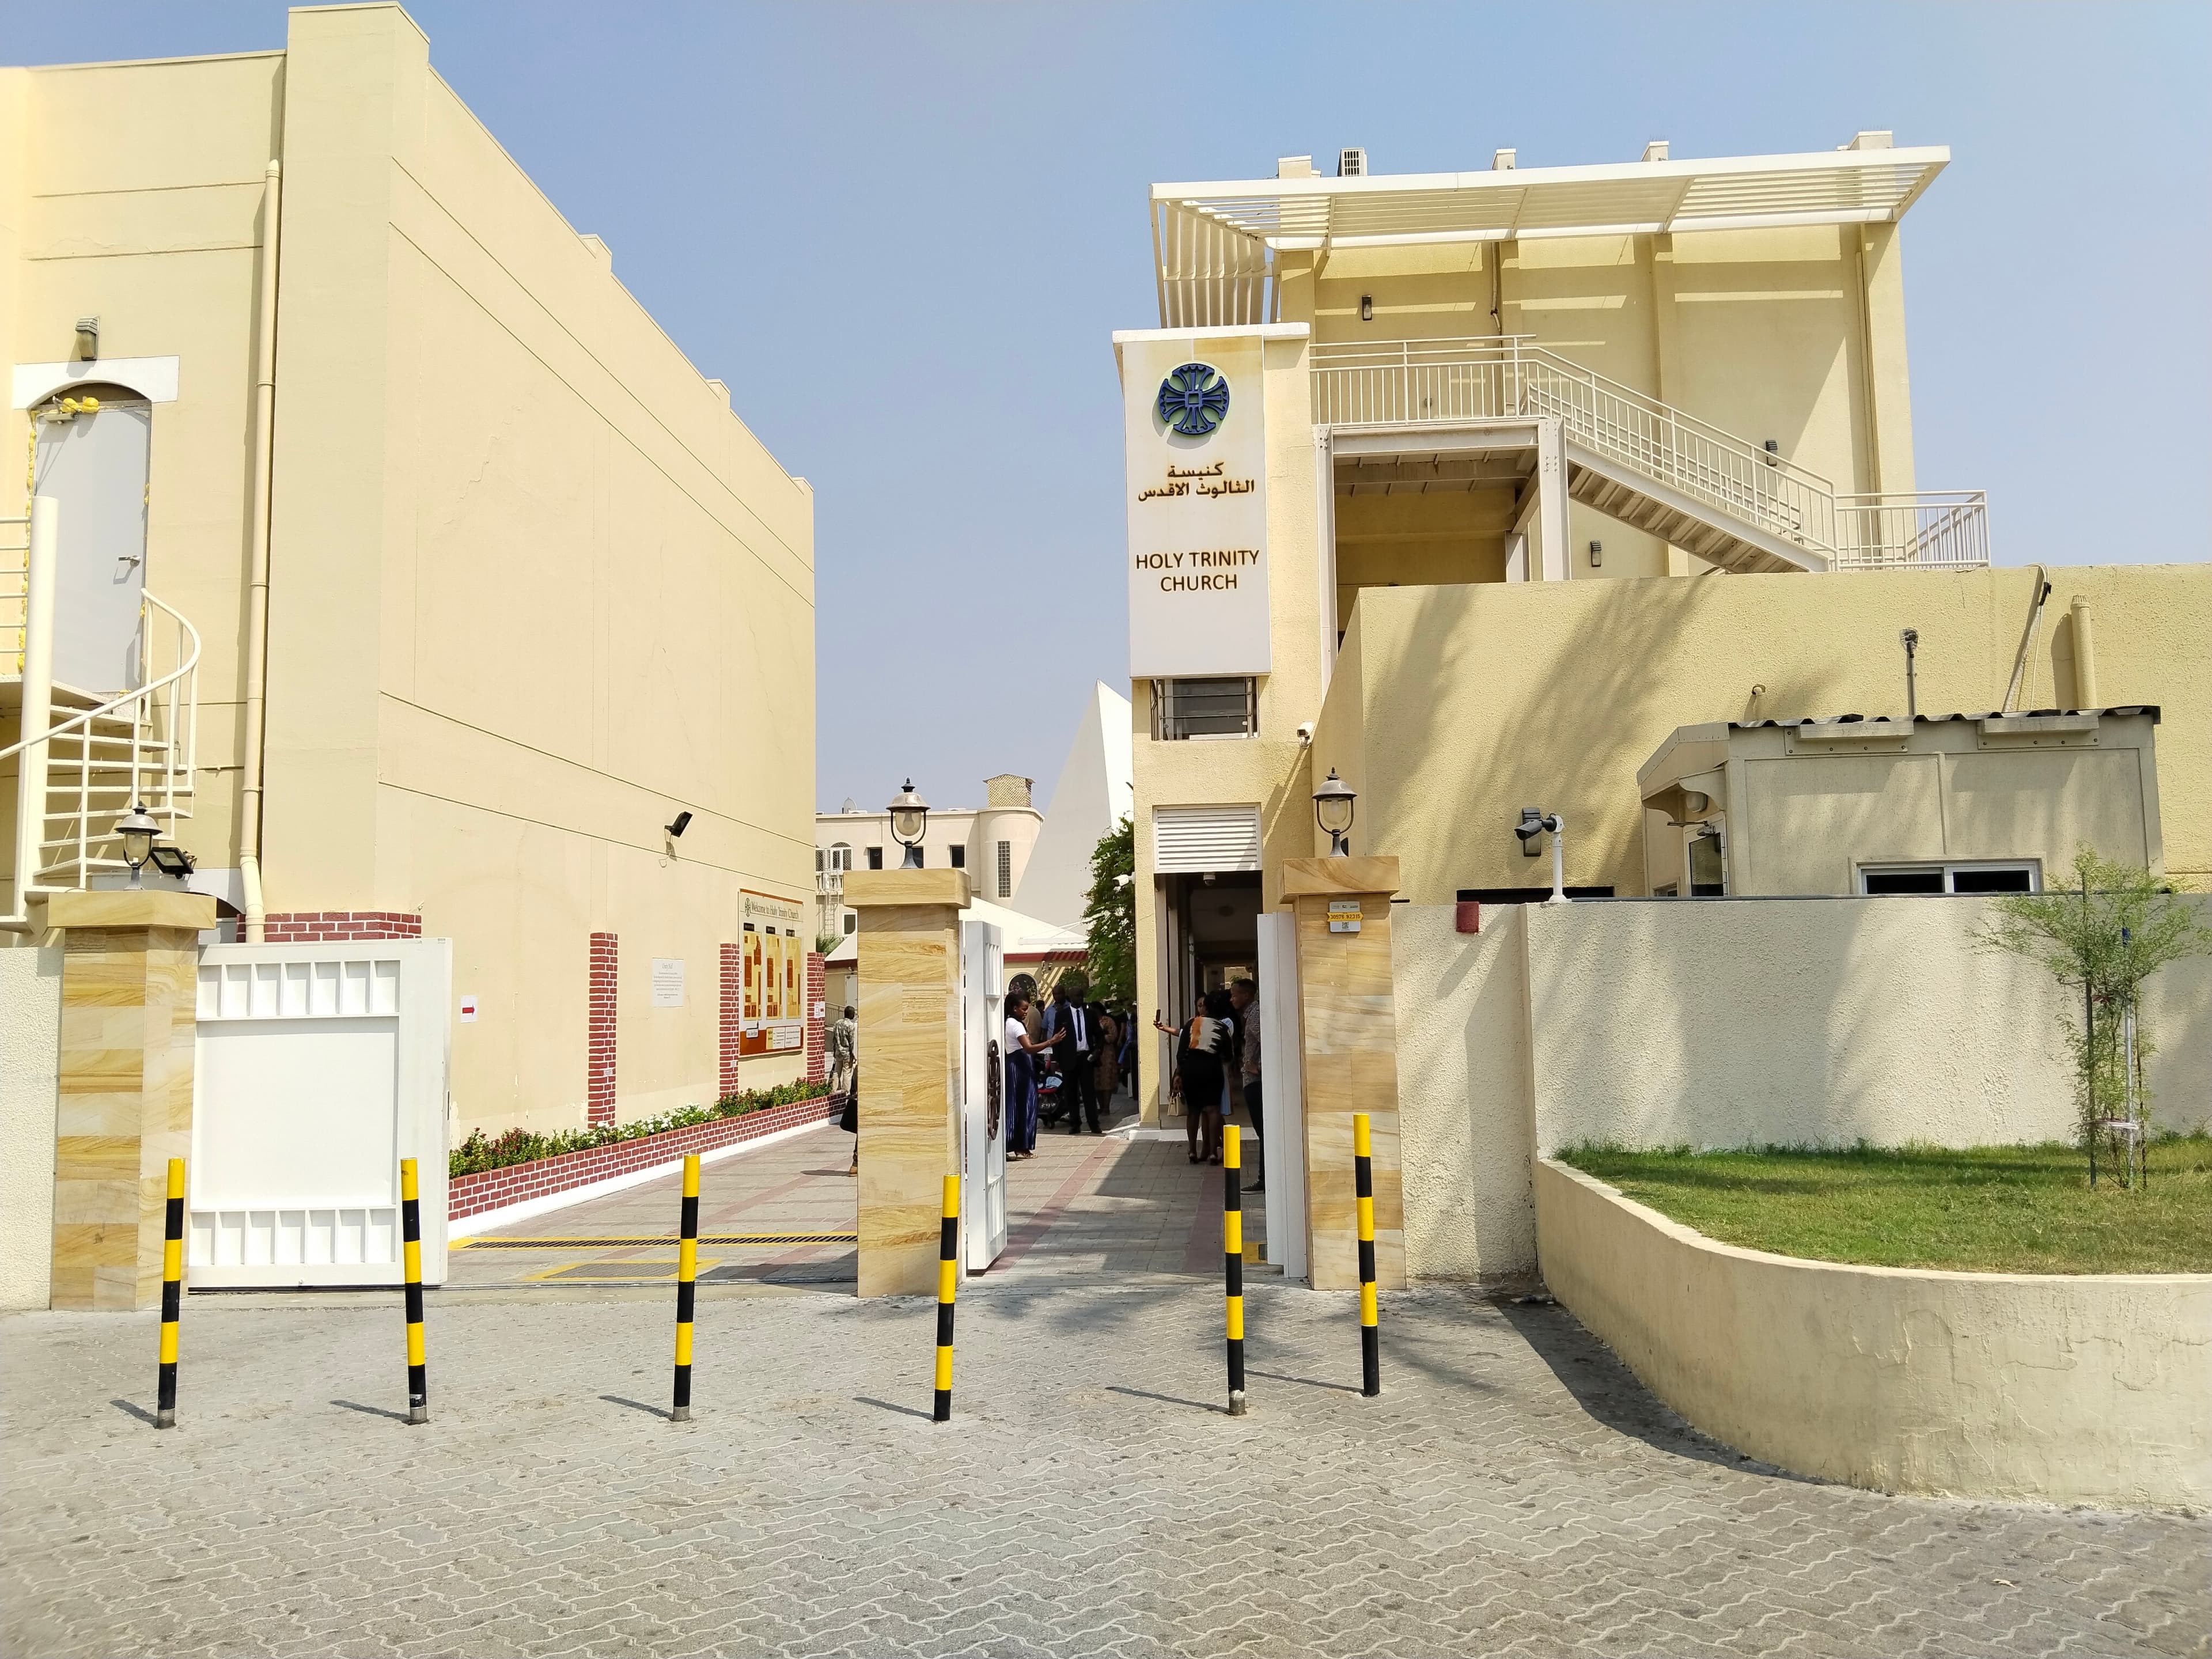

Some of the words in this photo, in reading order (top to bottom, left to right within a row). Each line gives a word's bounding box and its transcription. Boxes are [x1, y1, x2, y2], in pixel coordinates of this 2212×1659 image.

[1167, 462, 1224, 480] كنيسة
[1138, 482, 1190, 502] الاقدس
[1196, 479, 1255, 499] الثالوث
[1136, 552, 1184, 569] HOLY
[1189, 550, 1260, 567] TRINITY
[1160, 574, 1237, 592] CHURCH
[751, 901, 766, 914] Welcome
[778, 907, 787, 918] Trinity
[788, 908, 800, 919] Church
